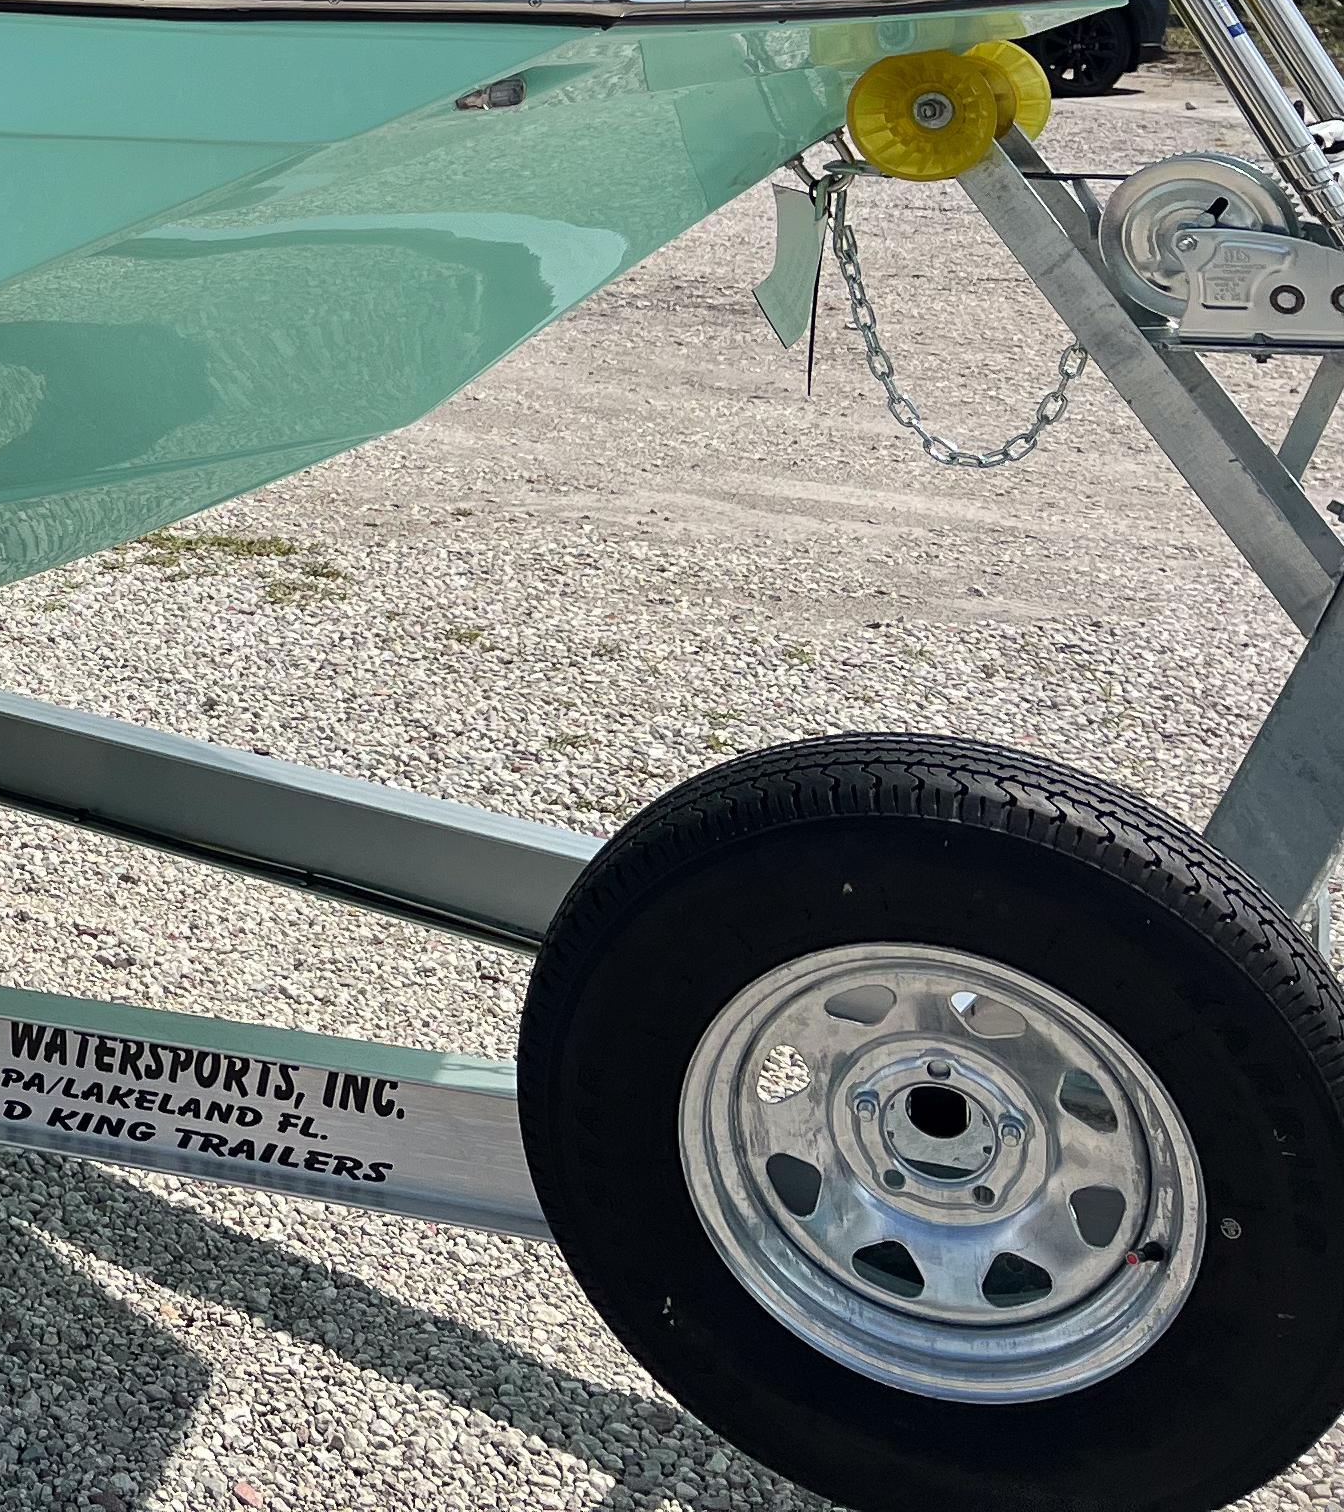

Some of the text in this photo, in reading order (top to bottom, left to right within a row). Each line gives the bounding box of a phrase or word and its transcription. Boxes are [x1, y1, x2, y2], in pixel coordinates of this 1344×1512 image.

[11, 1021, 305, 1109] WATERSPORTS,
[322, 1071, 405, 1119] INC.
[46, 1107, 156, 1141] KING
[175, 1128, 393, 1182] TRAILERS
[277, 1113, 328, 1141] FL.
